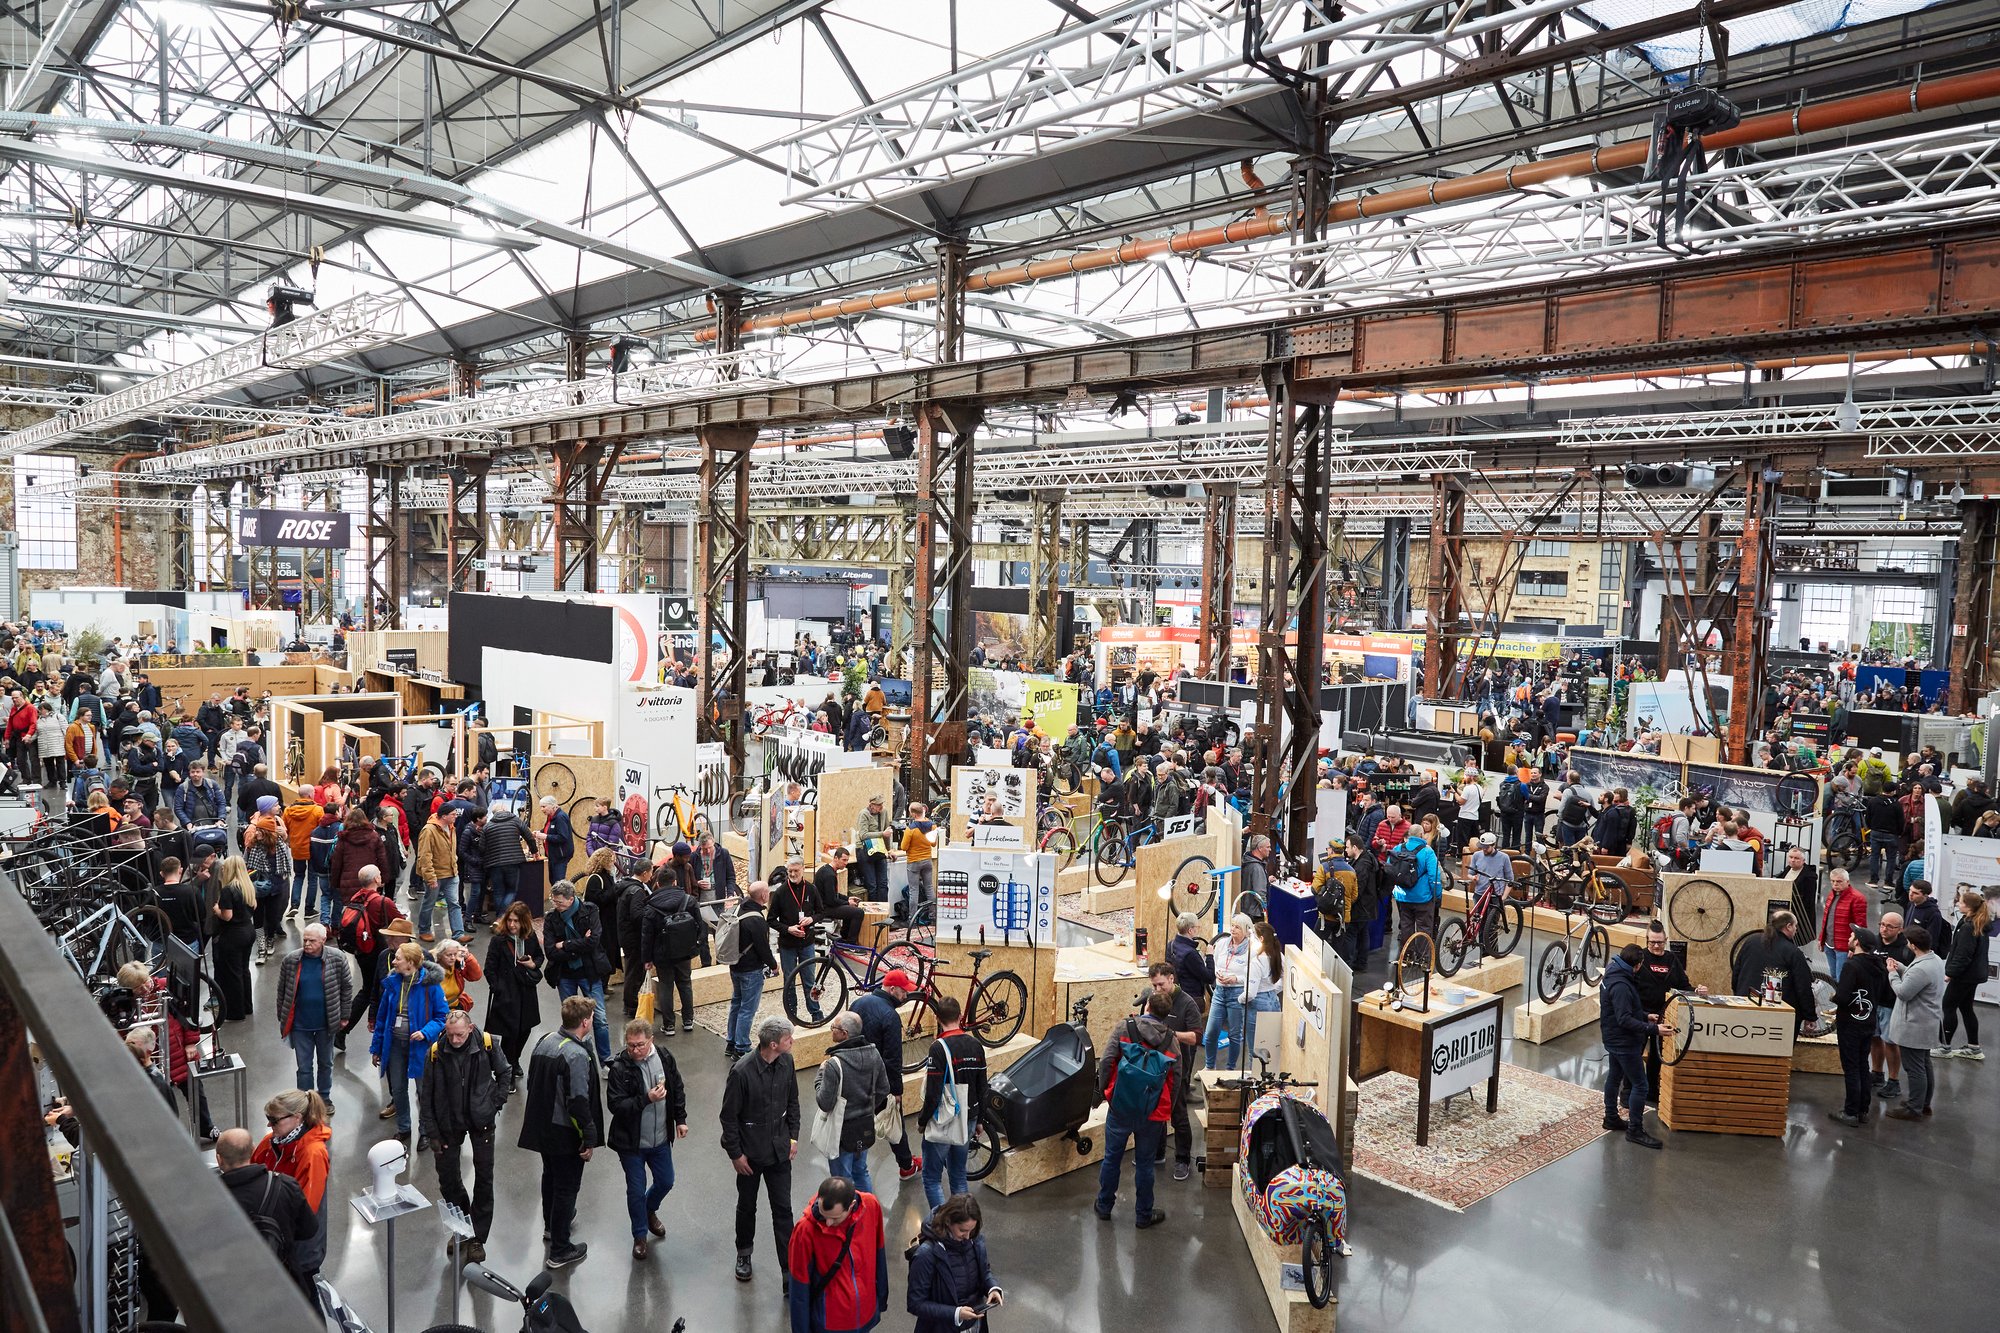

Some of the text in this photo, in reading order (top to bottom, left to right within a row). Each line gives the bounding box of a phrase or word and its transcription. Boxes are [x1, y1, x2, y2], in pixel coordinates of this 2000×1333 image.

[1674, 101, 1691, 110] PLUS
[242, 517, 257, 538] ROSE
[277, 519, 337, 540] ROSE
[1470, 640, 1537, 653] Schumacher
[648, 695, 682, 706] vittoria
[1034, 689, 1055, 703] RIDE
[1033, 700, 1062, 714] STYLE
[1167, 819, 1191, 834] SES
[1693, 1022, 1783, 1041] PIROPE
[1451, 1024, 1494, 1062] ROTOR
